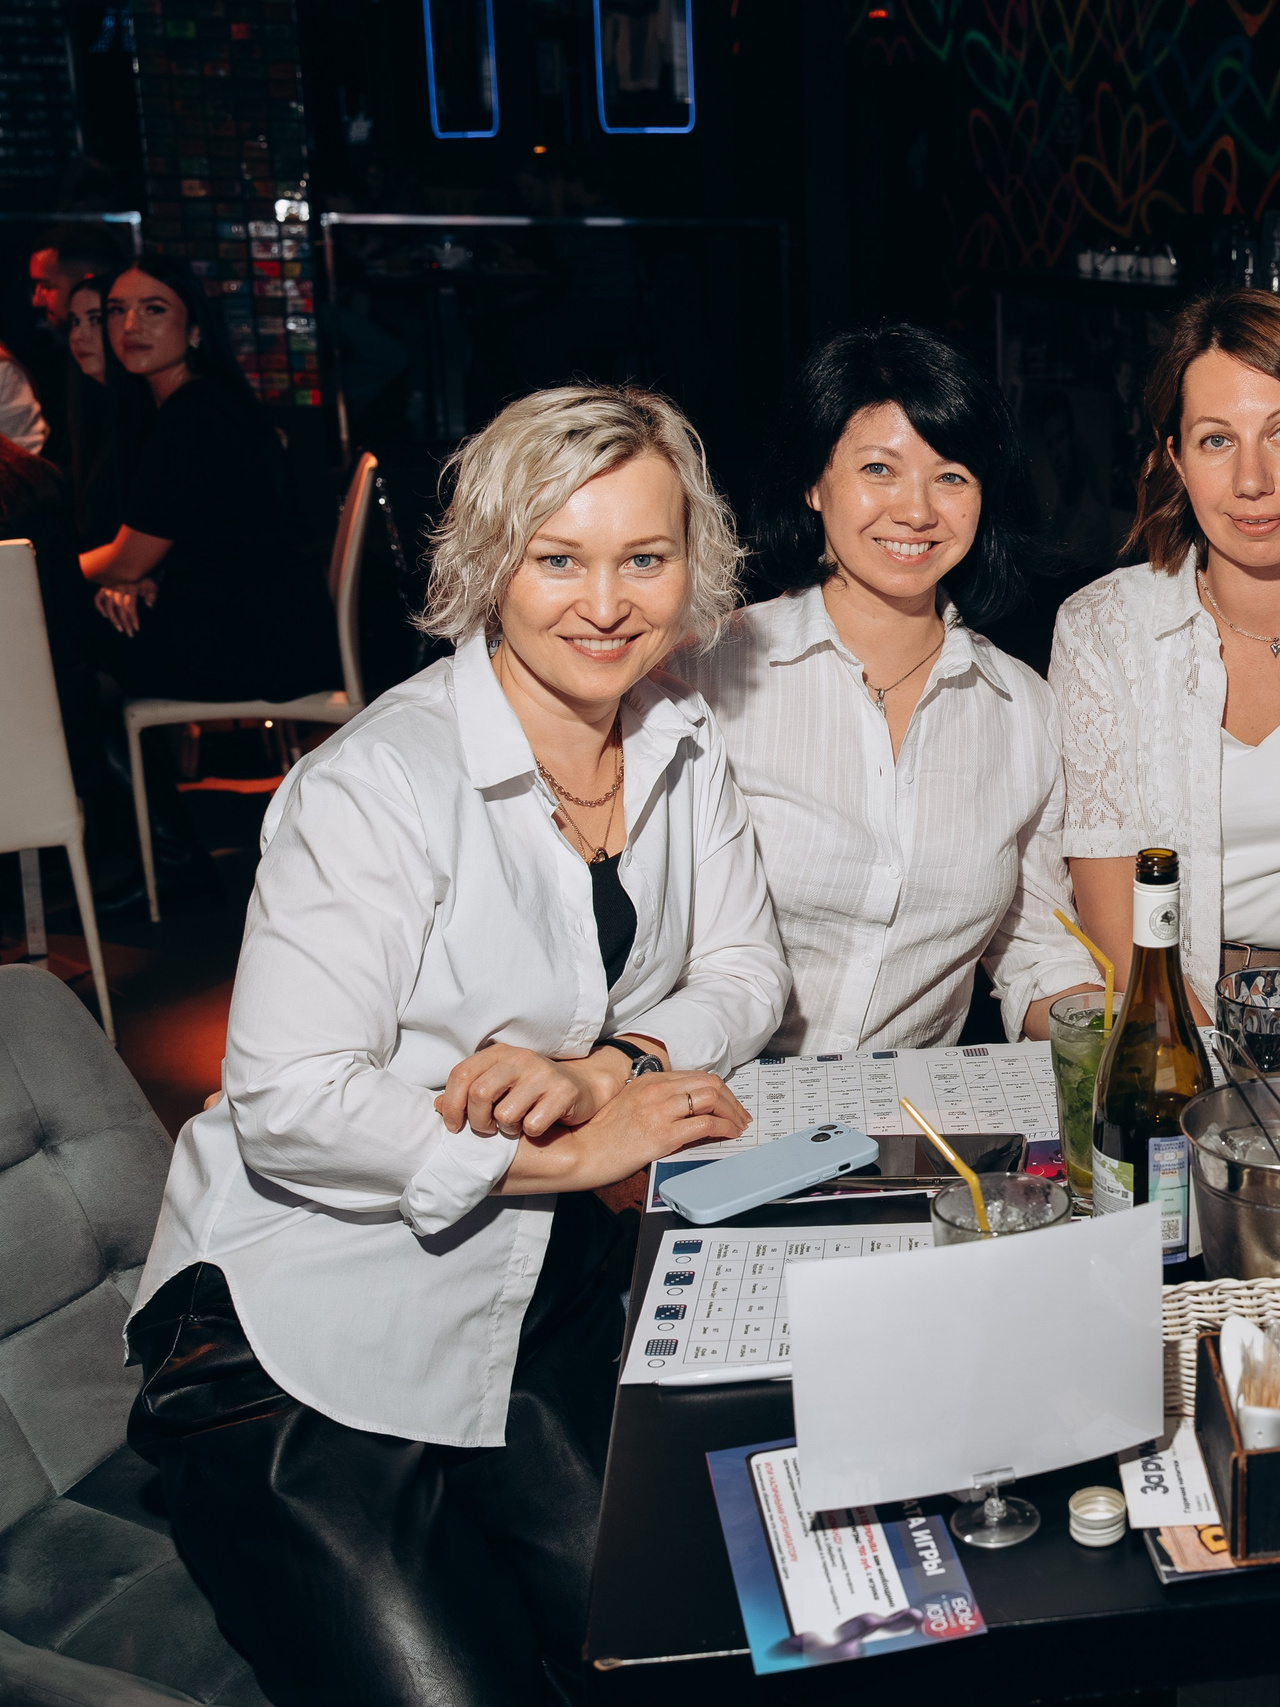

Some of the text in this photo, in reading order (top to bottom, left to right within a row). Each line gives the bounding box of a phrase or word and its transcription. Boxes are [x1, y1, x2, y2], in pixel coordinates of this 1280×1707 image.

[768, 1477, 784, 1514] НАЛИЧНЫМИ
[779, 1515, 798, 1562] ОРГАНИЗАТОРУ
[910, 1529, 946, 1577] ИГРЫ
[868, 1577, 878, 1600] игрока
